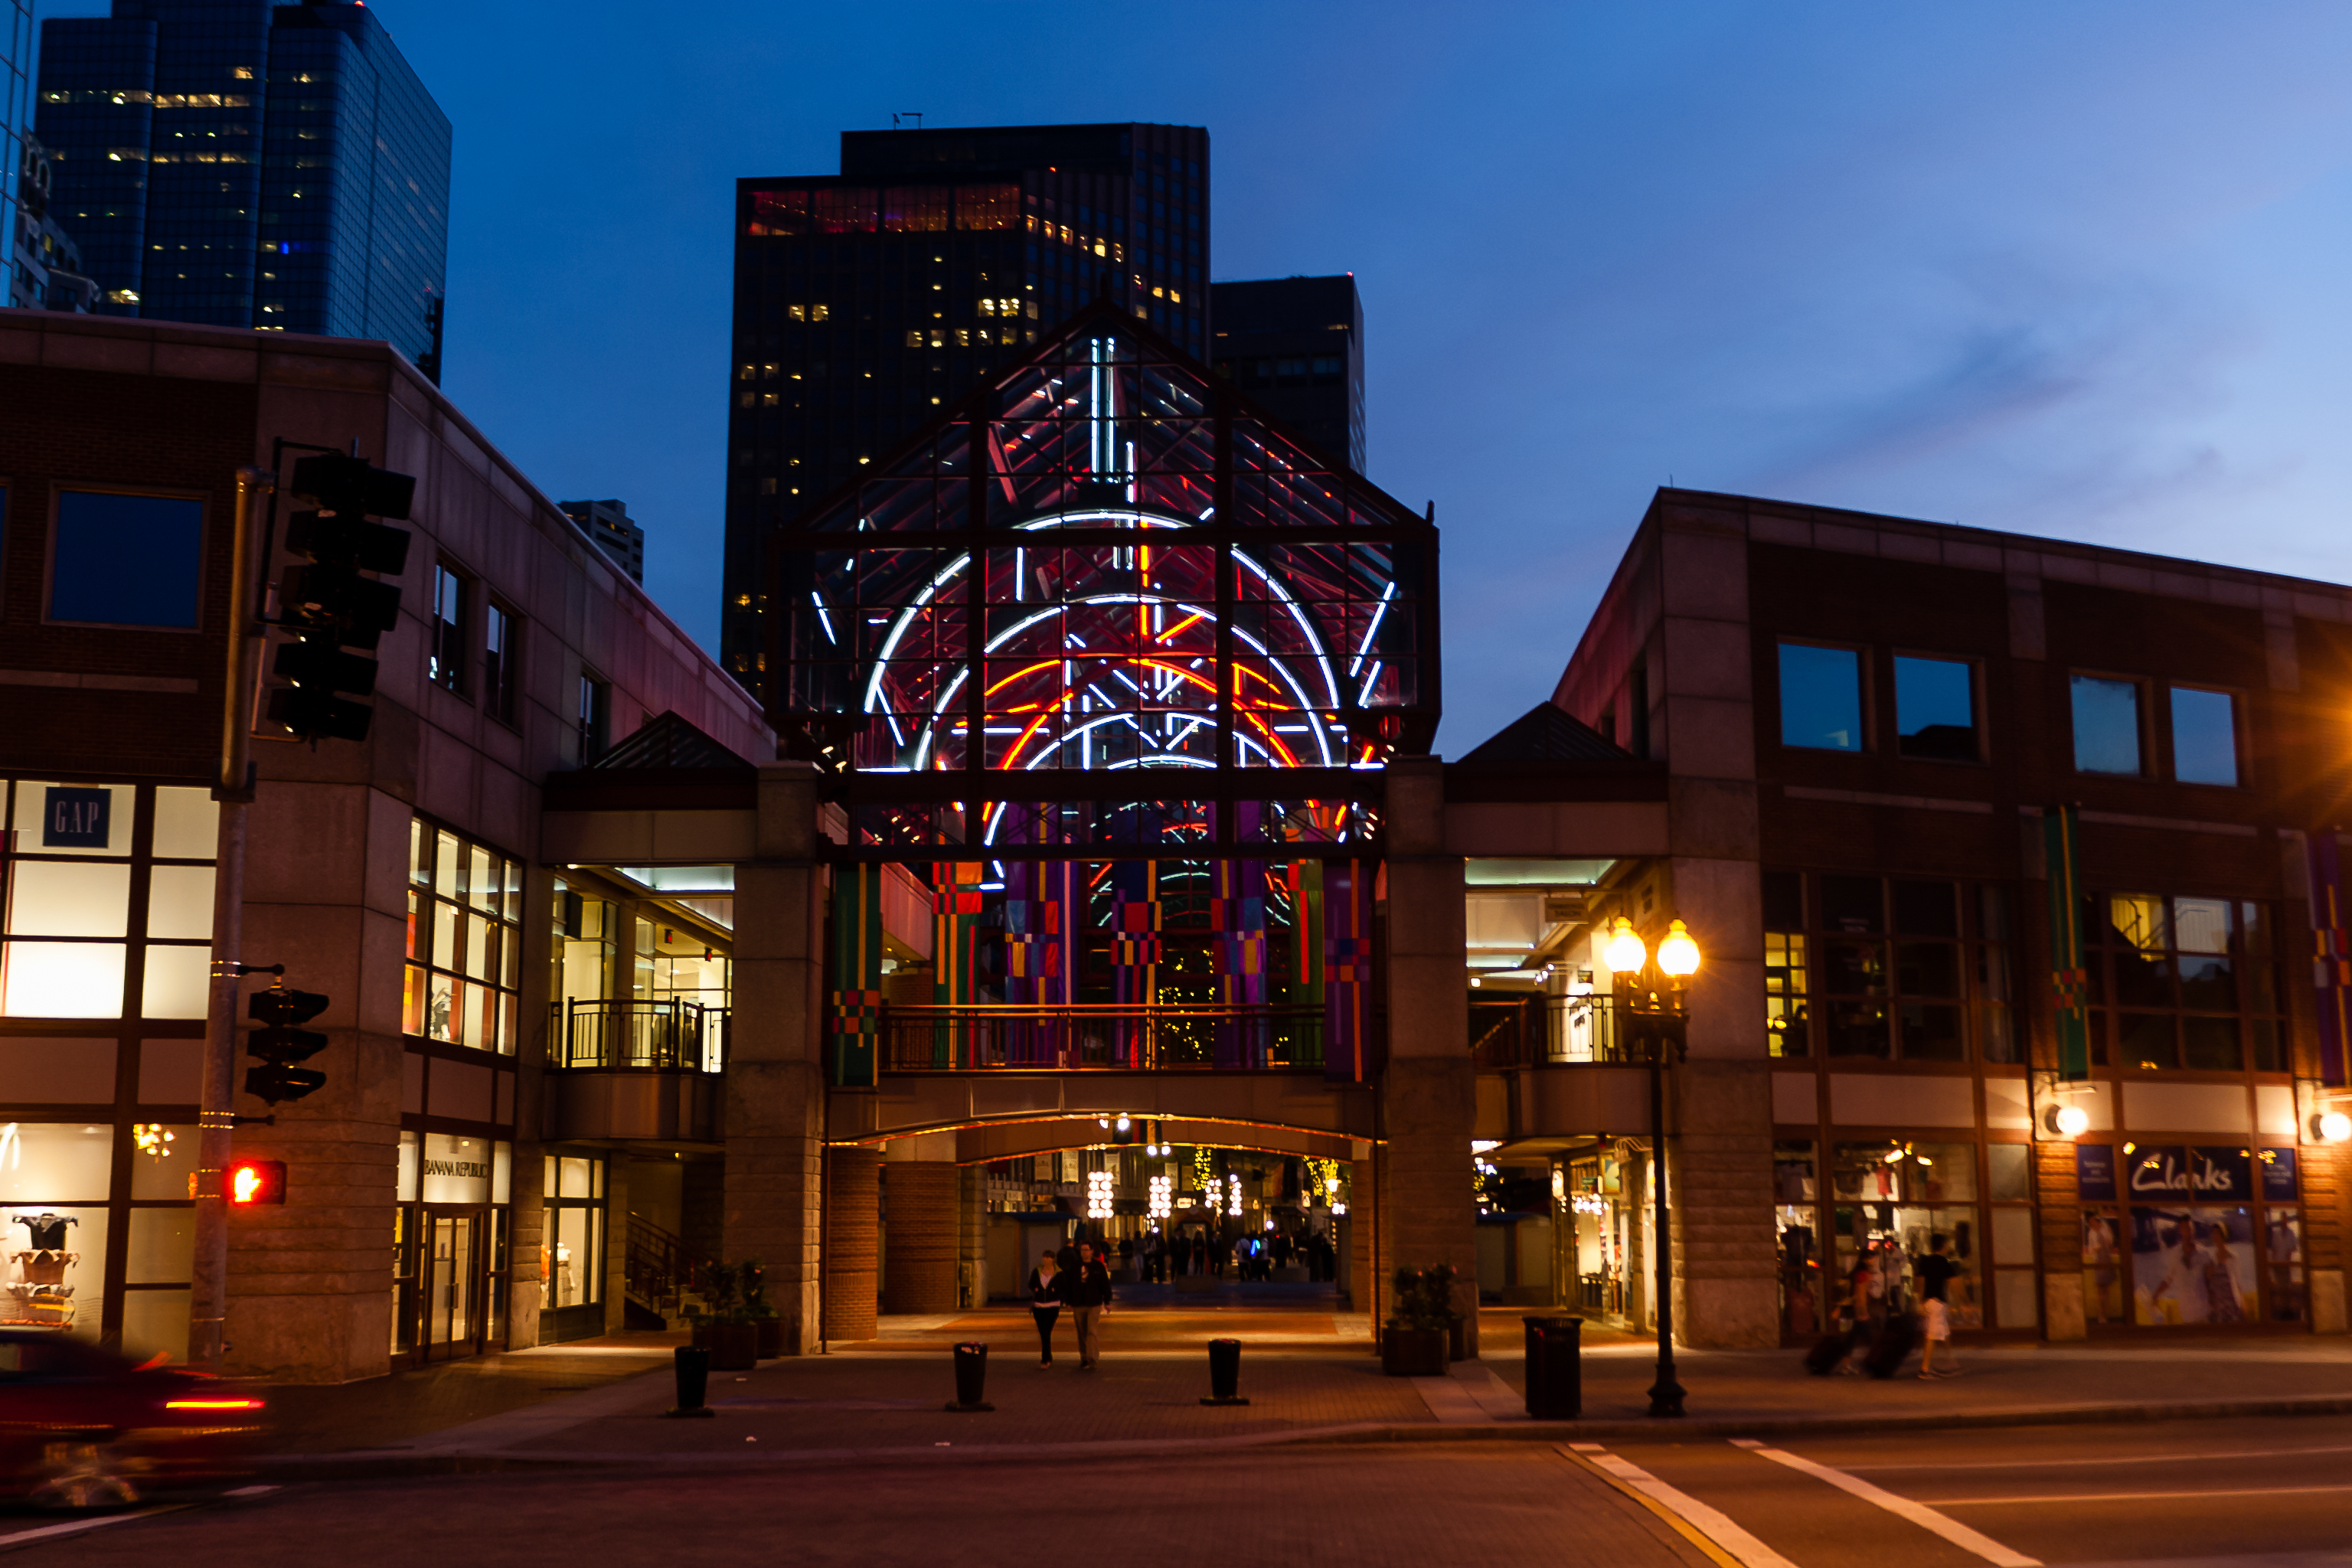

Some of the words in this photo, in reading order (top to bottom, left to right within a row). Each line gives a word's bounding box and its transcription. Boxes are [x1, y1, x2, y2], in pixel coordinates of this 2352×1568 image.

[54, 800, 100, 834] GAP
[424, 1159, 455, 1176] BANANA
[456, 1161, 488, 1178] REPUBLIC
[2132, 1153, 2233, 1191] Clarks
